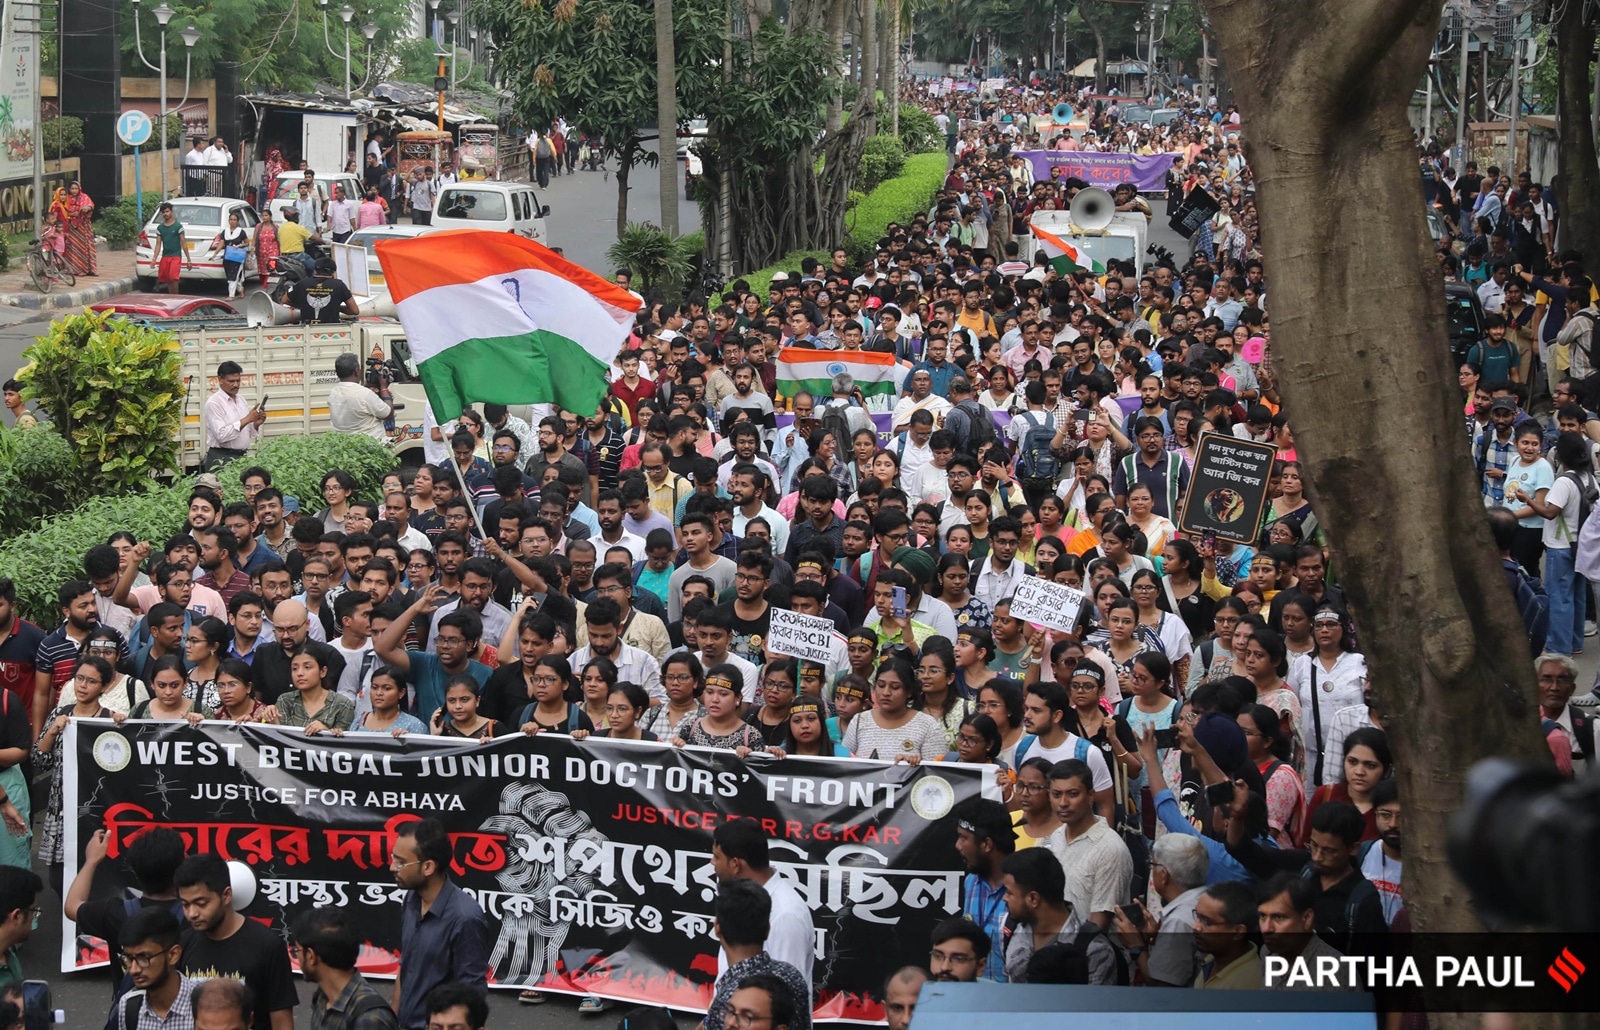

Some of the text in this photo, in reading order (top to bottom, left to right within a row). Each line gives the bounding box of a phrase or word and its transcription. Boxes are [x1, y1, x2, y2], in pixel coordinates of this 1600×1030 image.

[1208, 443, 1221, 452] মন
[1222, 446, 1236, 455] মুখ
[1236, 450, 1253, 458] এক
[1210, 456, 1258, 471] জাস্টিস ফর
[1203, 467, 1261, 486] আর জি কর
[1017, 586, 1036, 600] CBI
[808, 632, 831, 648] CBI
[771, 640, 781, 651] WE
[782, 642, 806, 656] DEMAND
[805, 647, 831, 662] JUSTICE
[717, 679, 732, 688] JUSTICE
[136, 740, 243, 767] WEST
[258, 744, 403, 777] BENGAL
[418, 753, 550, 780] JUNIOR
[565, 756, 750, 797] DOCTORS'
[767, 776, 902, 809] FRONT
[190, 783, 466, 811] JUSTICE FOR ABHAYA
[611, 803, 718, 830] JUSTICE
[323, 813, 508, 876] দািতে
[515, 833, 720, 903] শপথের
[259, 878, 350, 909] স্বাস্থ্য
[357, 881, 409, 907] ভব
[548, 885, 663, 933] সিজিও
